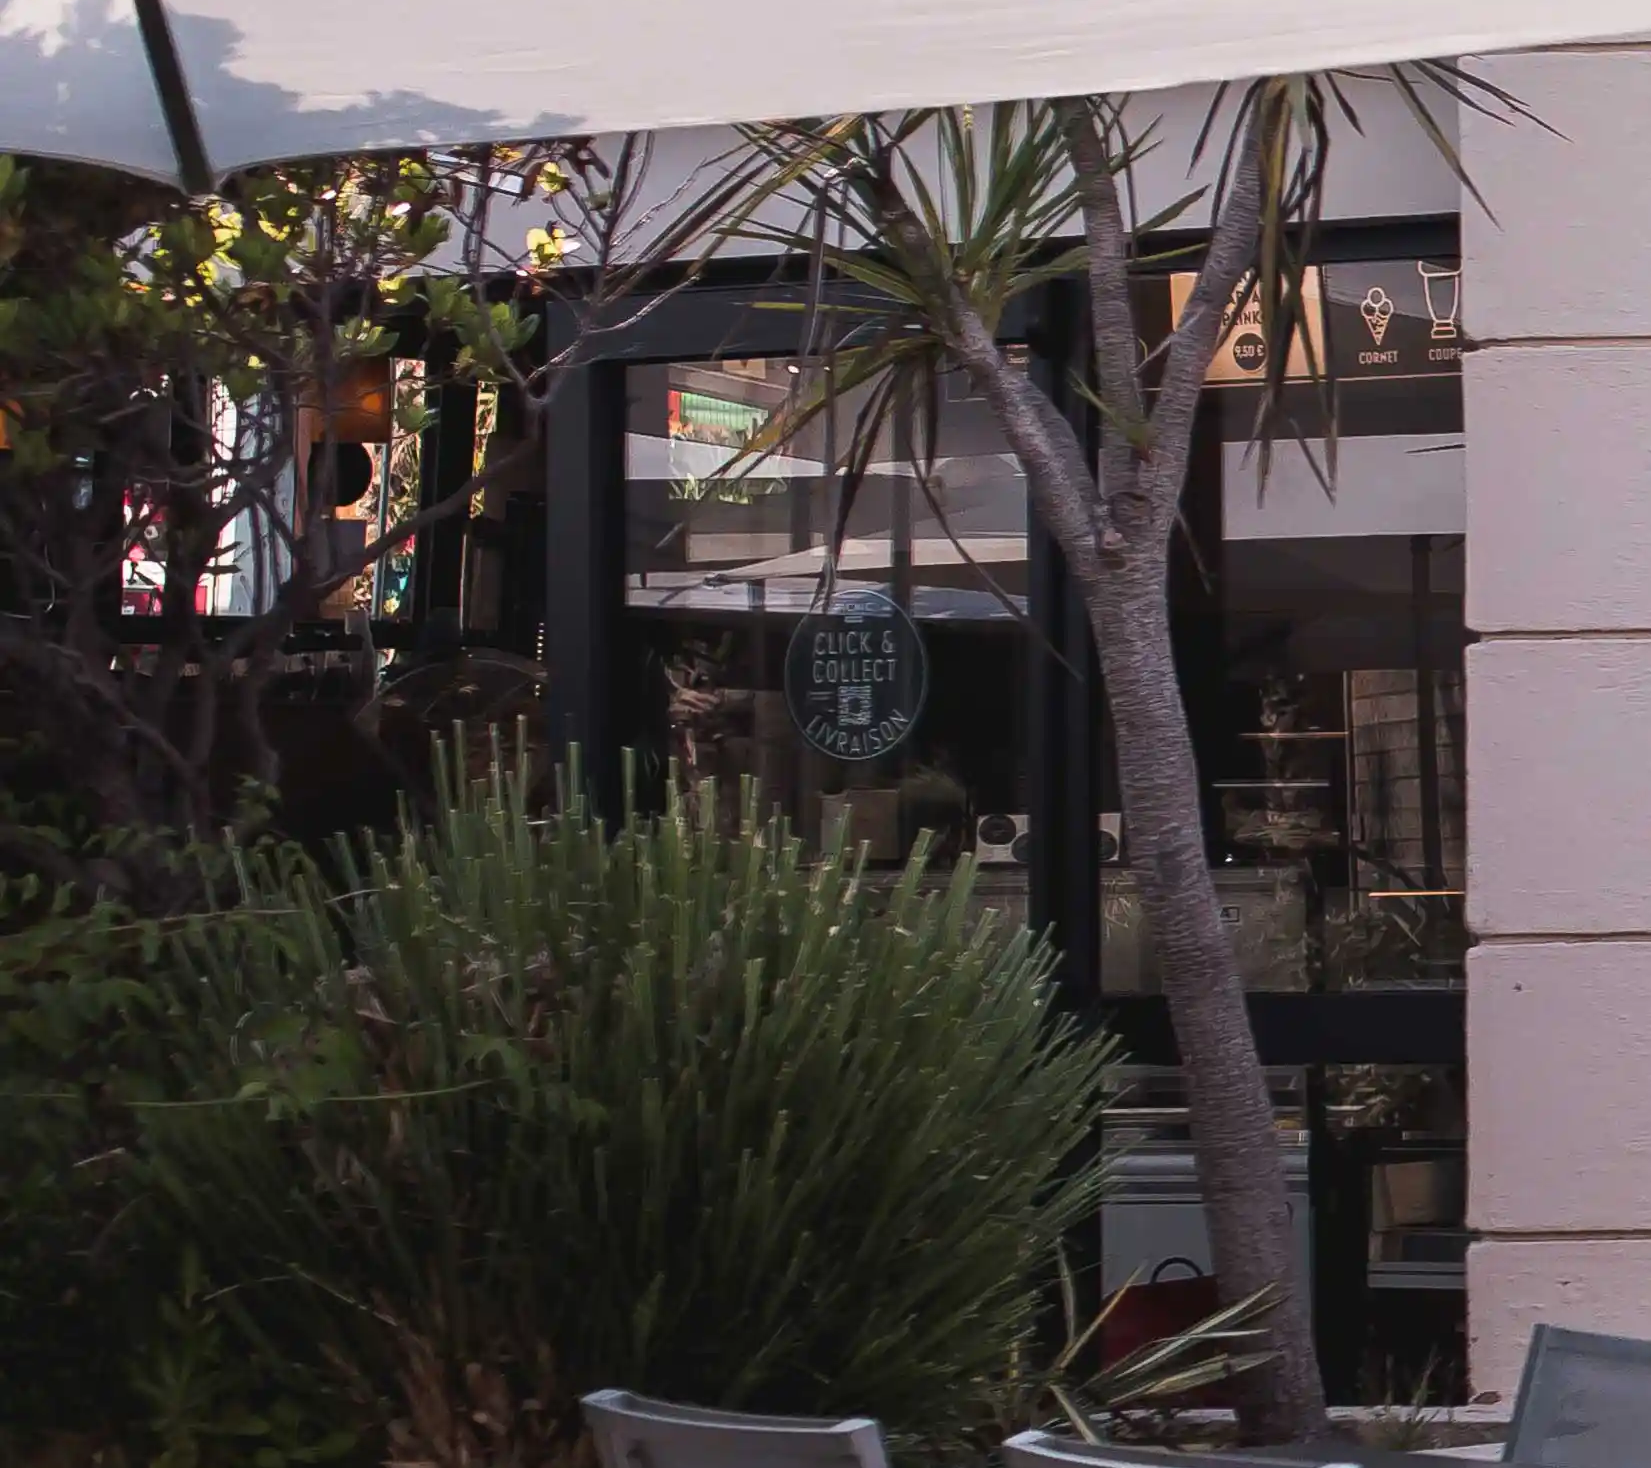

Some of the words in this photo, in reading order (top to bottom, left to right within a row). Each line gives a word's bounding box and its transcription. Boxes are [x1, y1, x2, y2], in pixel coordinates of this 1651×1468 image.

[1358, 350, 1398, 364] CORNET
[814, 631, 872, 655] CLICK
[881, 630, 896, 653] &
[812, 658, 898, 683] COLLECT
[806, 709, 909, 753] LIVRAISON
